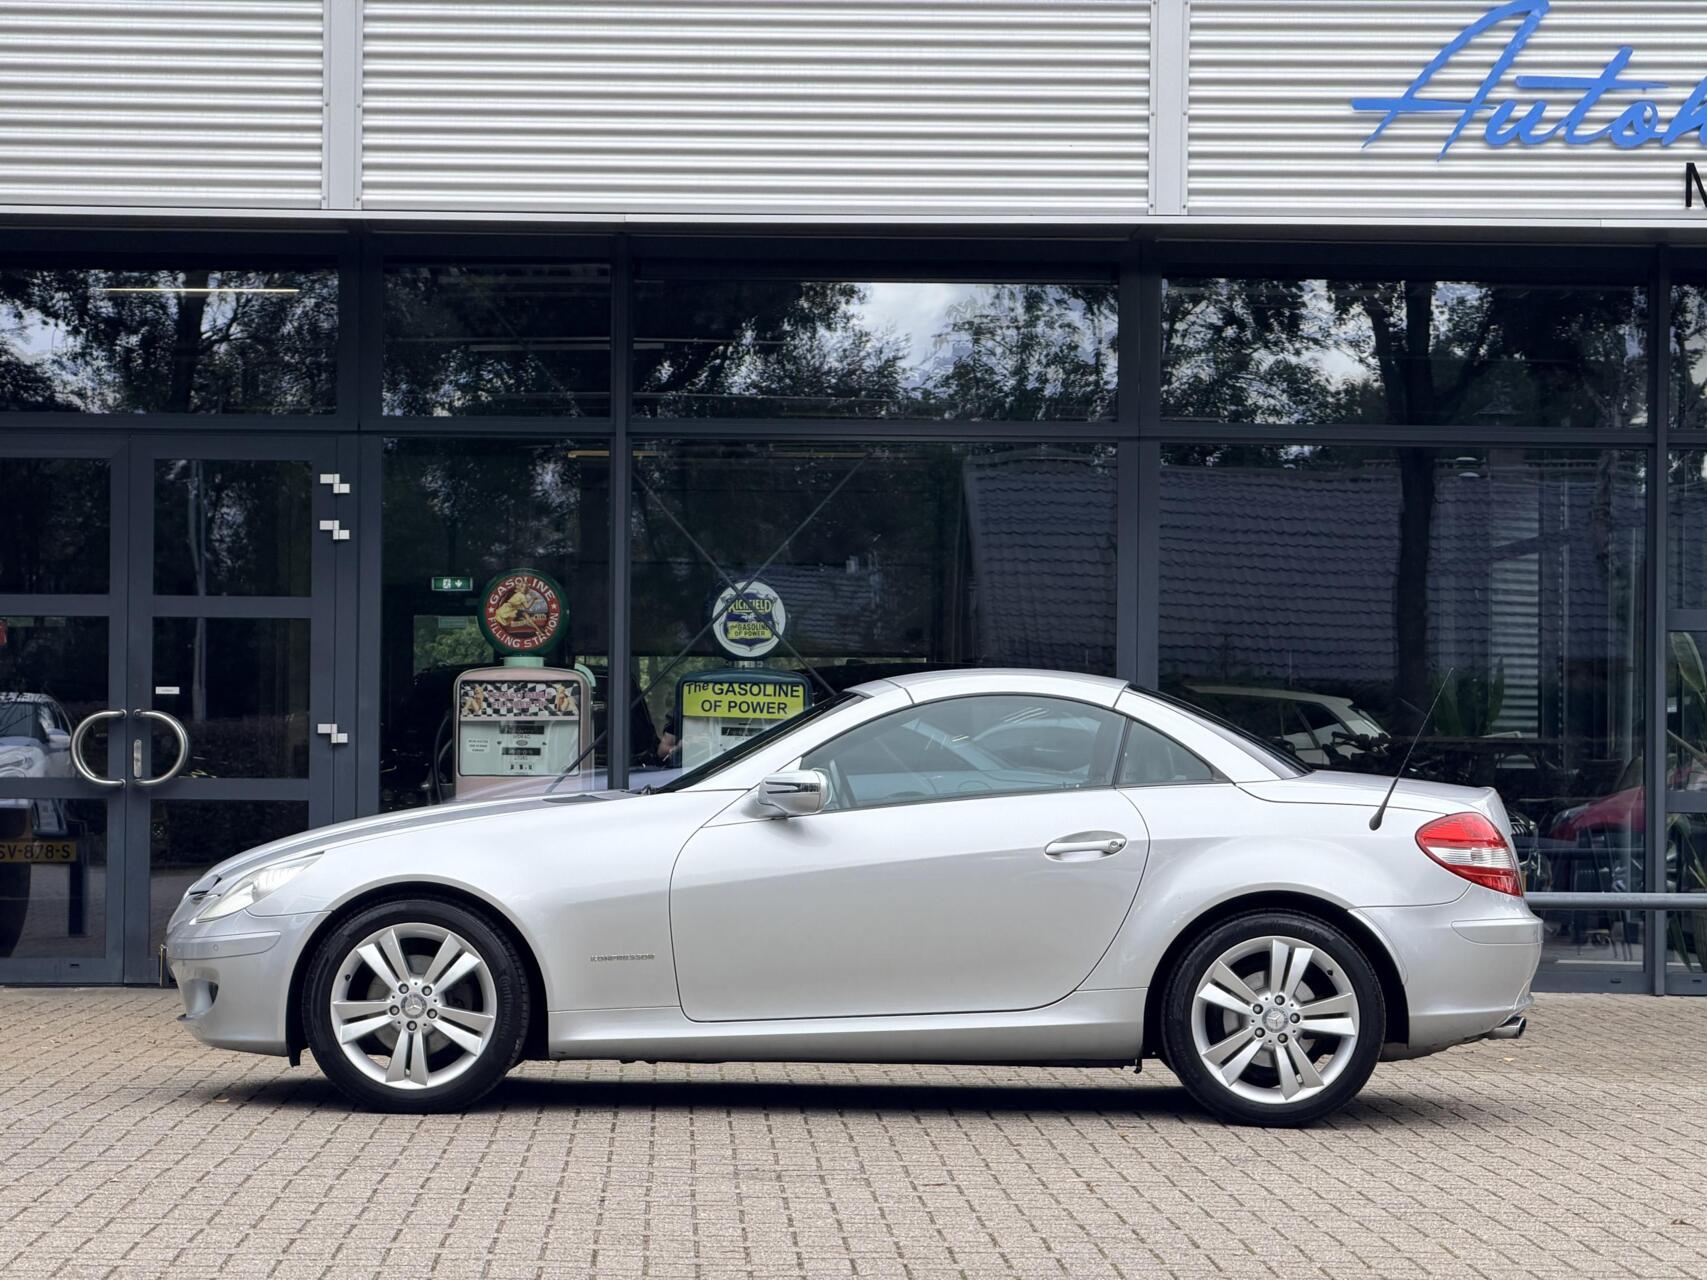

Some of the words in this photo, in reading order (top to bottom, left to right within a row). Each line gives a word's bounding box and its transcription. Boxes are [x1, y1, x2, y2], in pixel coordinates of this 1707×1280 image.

[489, 576, 556, 605] GASOLINE
[487, 617, 521, 648] FILLING
[523, 612, 559, 648] STATION
[686, 681, 709, 694] The
[711, 682, 801, 698] GASOLINE
[701, 699, 723, 713] OF
[727, 700, 788, 715] POWER
